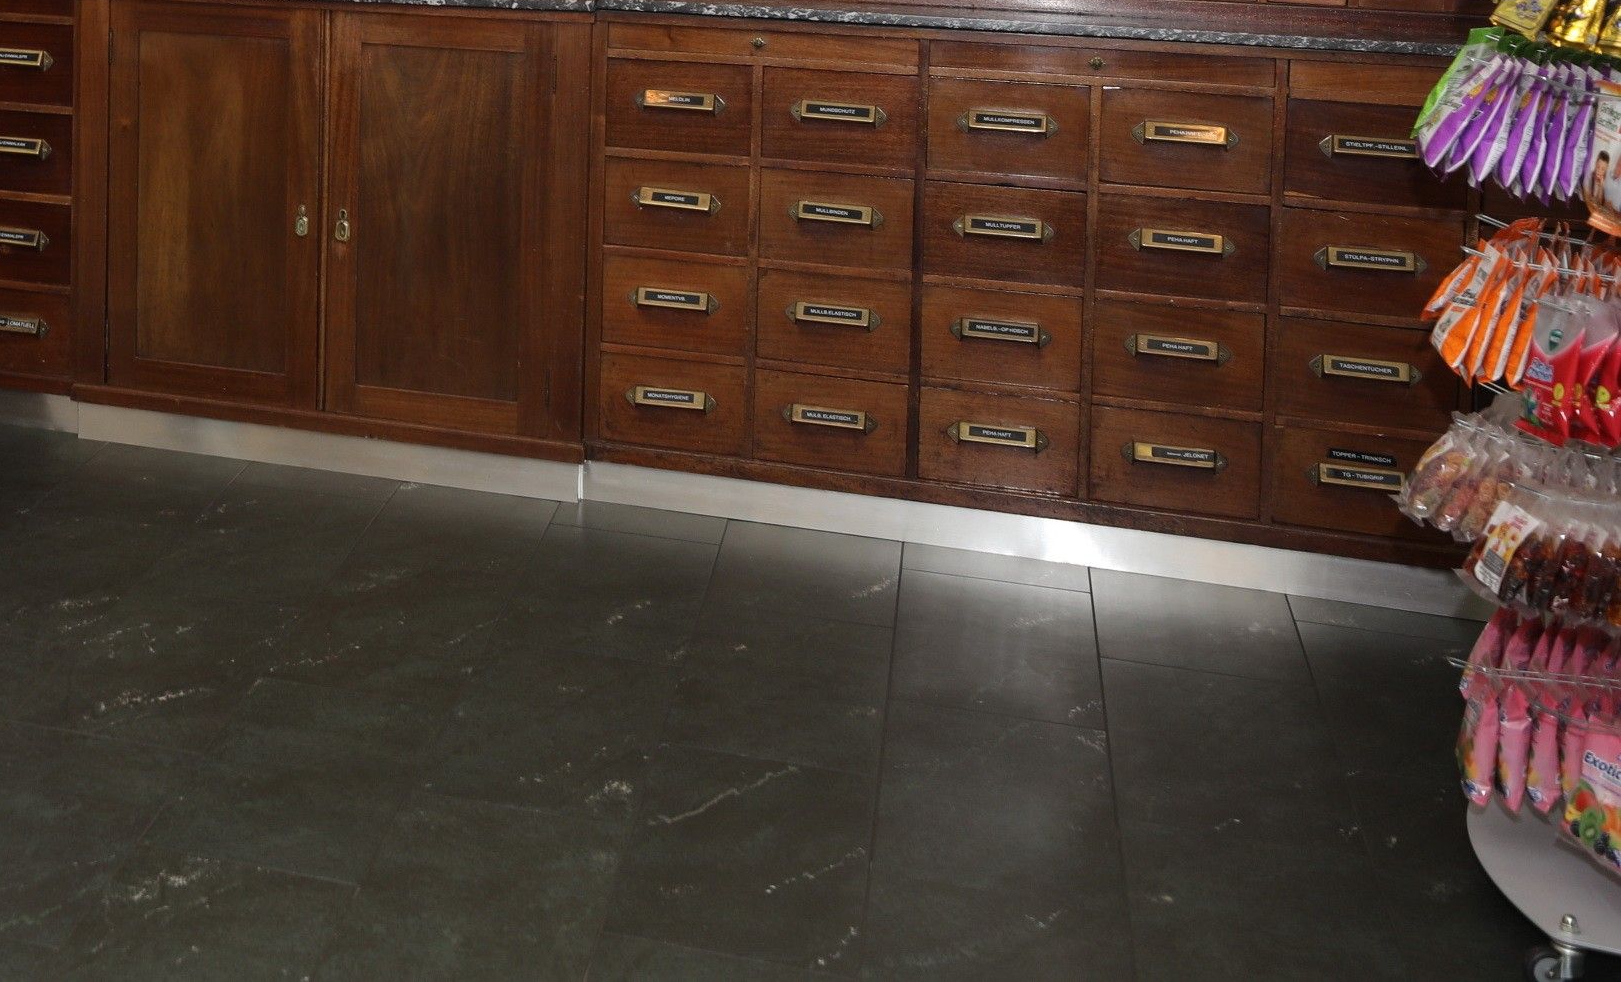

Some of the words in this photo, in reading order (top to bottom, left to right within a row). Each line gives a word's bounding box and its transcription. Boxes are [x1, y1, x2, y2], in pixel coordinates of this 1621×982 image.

[819, 106, 856, 114] MUNDSCHUTZ
[983, 115, 1035, 125] MULLKOMPRESSEN
[815, 207, 849, 216] MULLBINDEN
[985, 222, 1021, 231] MULLTUPFER
[1183, 452, 1209, 460] JELONET
[1332, 449, 1356, 460] TOPPER
